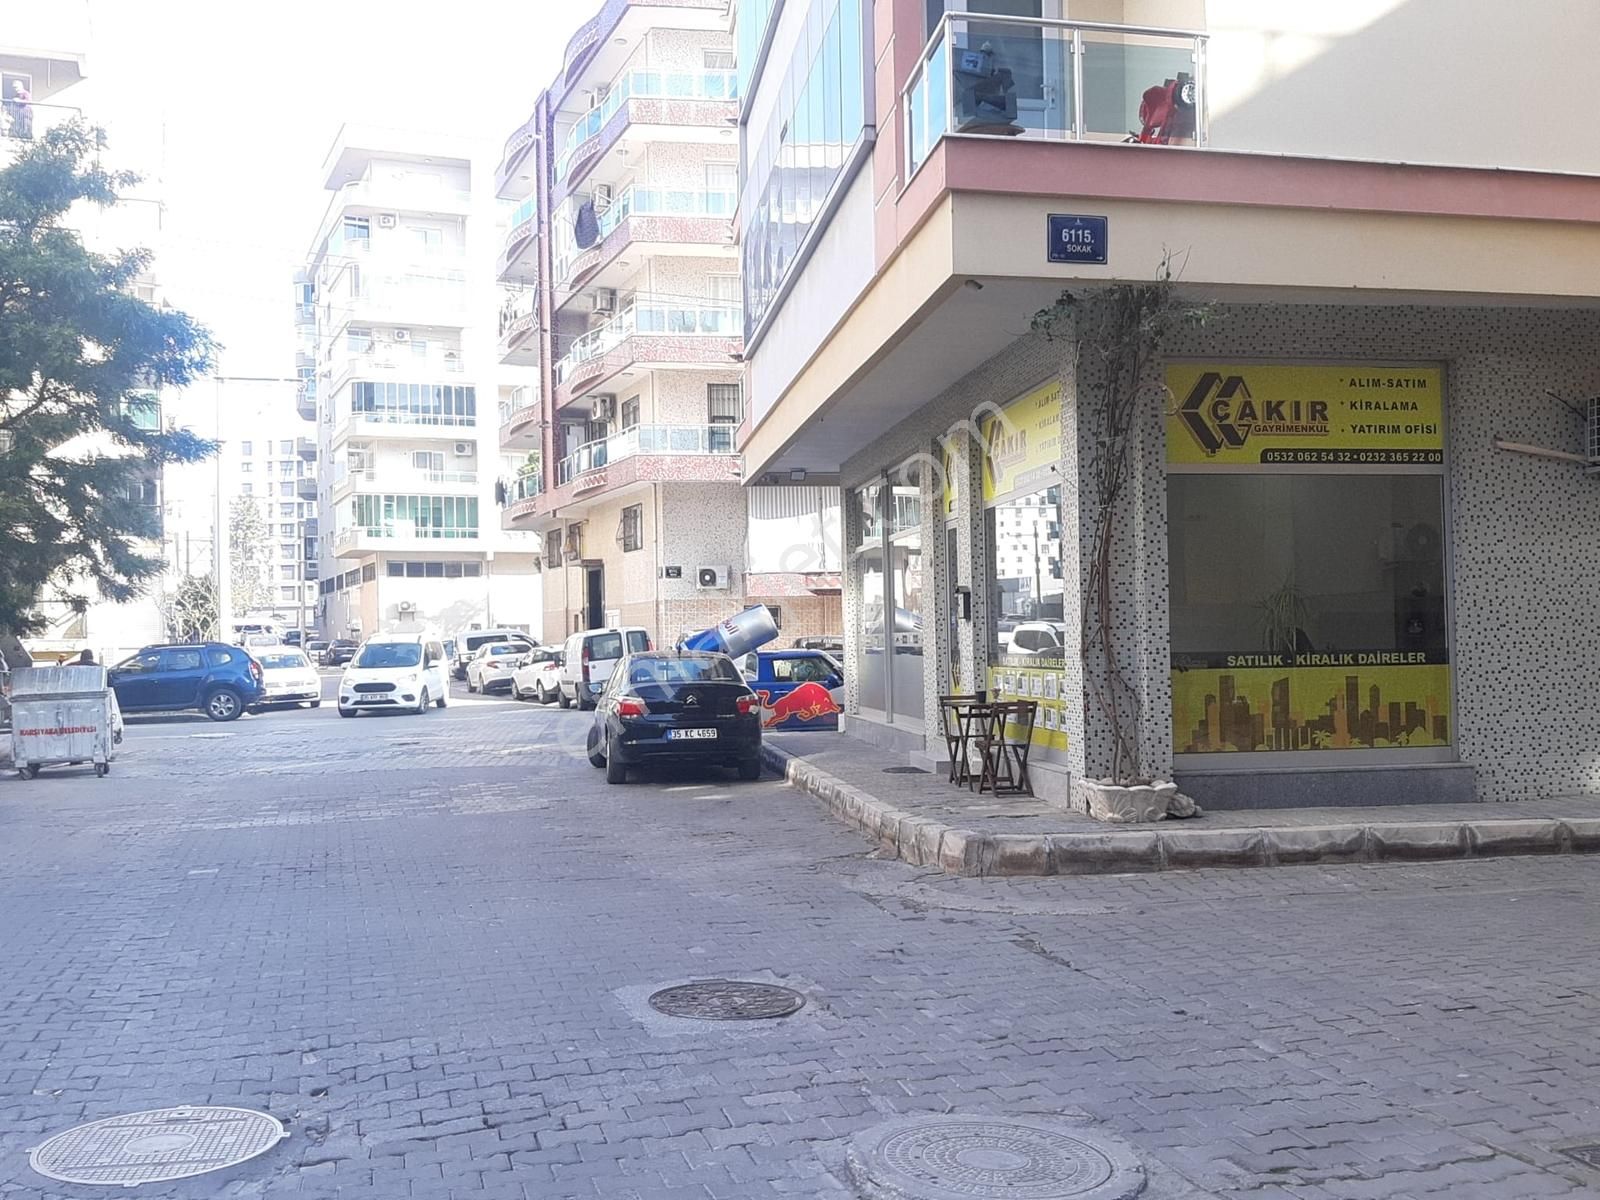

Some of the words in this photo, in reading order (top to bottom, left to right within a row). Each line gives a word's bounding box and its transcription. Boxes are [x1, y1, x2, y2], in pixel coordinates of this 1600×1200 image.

[1066, 244, 1092, 253] SOKAK
[1349, 378, 1427, 389] ALIM-SATIM
[1211, 399, 1329, 423] ÇAKIR
[1350, 400, 1418, 411] KİRALAMA
[1254, 423, 1330, 433] GAYRİMENKUL
[1350, 424, 1401, 434] YATIRIM
[1404, 423, 1437, 434] OFİSİ
[1267, 452, 1294, 462] 0532
[1297, 452, 1318, 462] 062
[1321, 452, 1334, 462] 54
[1337, 452, 1351, 462] 32
[1360, 452, 1386, 462] 0232
[1389, 452, 1409, 462] 365
[1412, 452, 1425, 462] 22
[1428, 452, 1441, 462] 00
[1227, 655, 1283, 666] SATILIK
[1296, 652, 1354, 666] KİRALIK
[1358, 652, 1426, 664] DAİRELER
[672, 730, 682, 738] 35
[685, 730, 695, 738] KC
[697, 729, 716, 738] 4659
